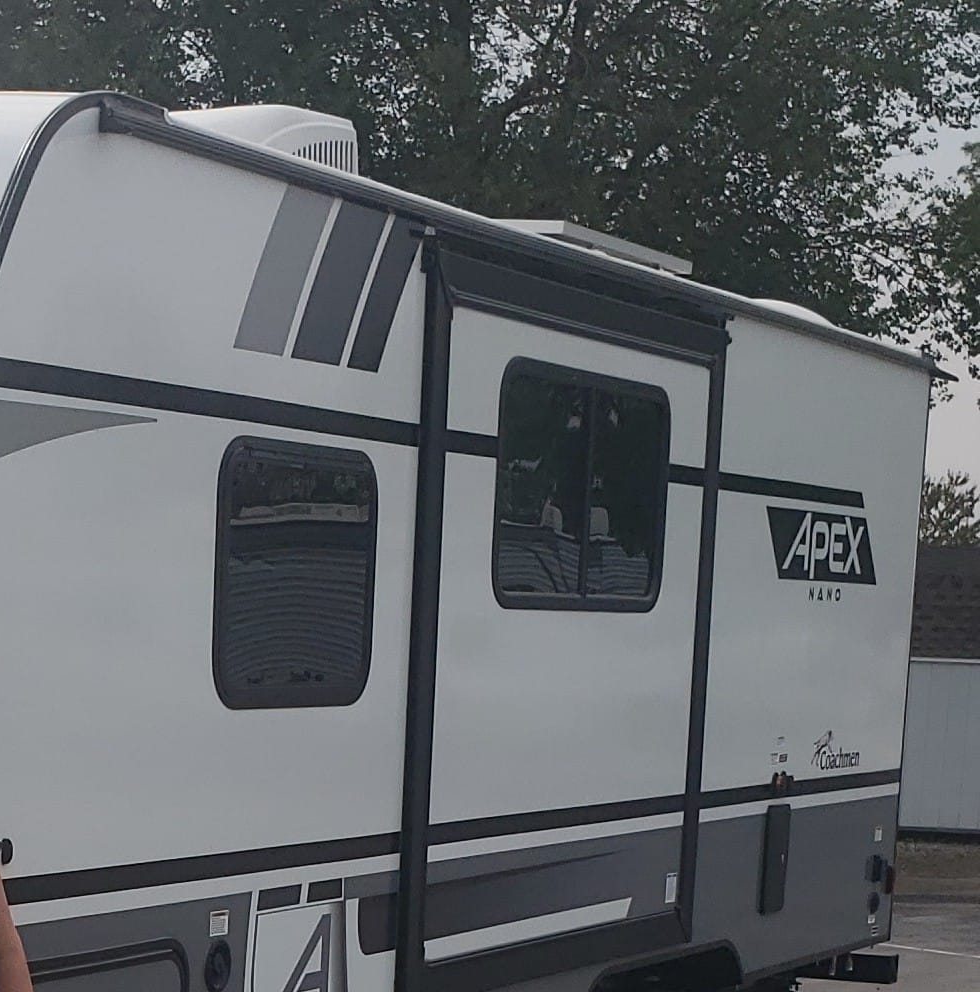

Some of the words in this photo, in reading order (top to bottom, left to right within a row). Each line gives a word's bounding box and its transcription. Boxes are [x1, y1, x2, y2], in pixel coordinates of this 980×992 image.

[782, 512, 864, 579] APEX
[808, 586, 841, 601] NANO
[820, 747, 860, 770] Coachmen
